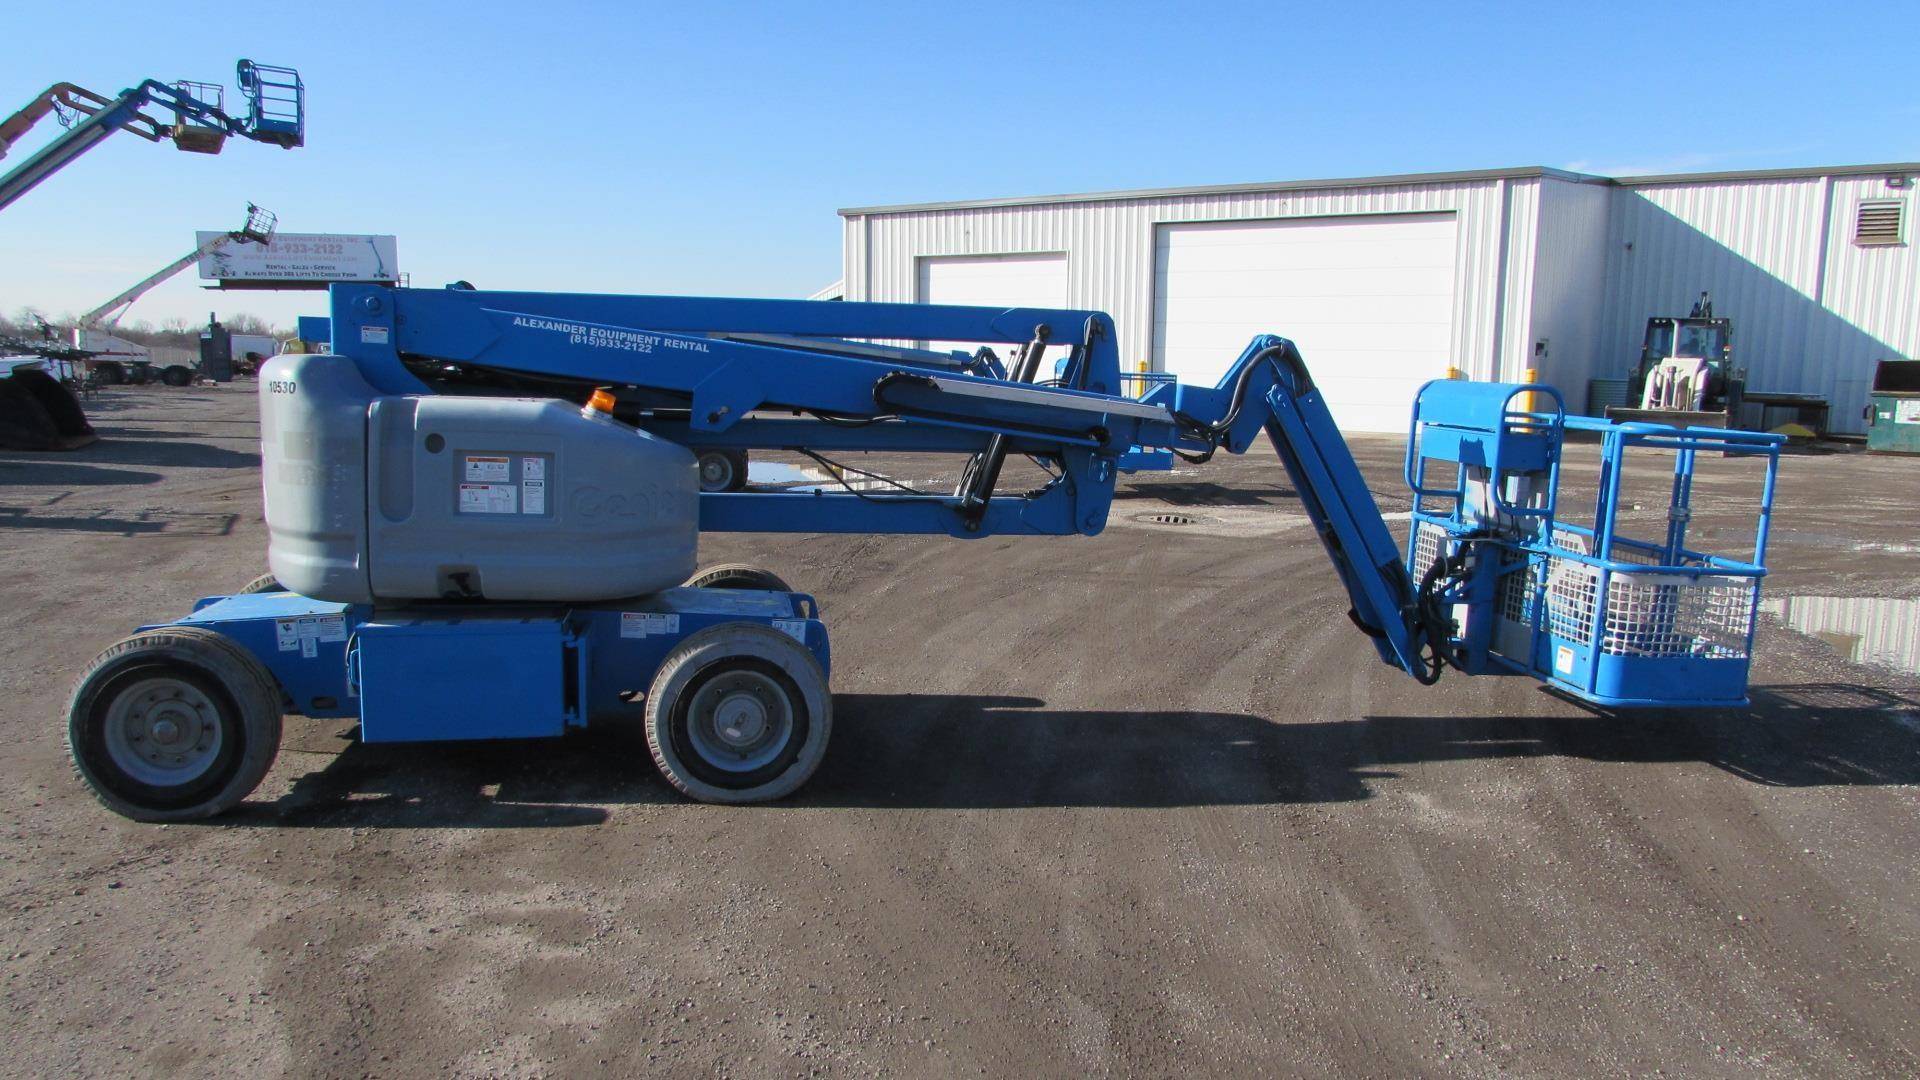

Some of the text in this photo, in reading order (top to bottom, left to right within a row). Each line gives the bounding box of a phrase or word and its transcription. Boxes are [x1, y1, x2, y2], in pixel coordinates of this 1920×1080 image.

[513, 316, 710, 353] ALEXANDER EQUIPMENT RENTAL
[570, 333, 653, 353] (815)933-2122
[269, 381, 297, 394] 10530
